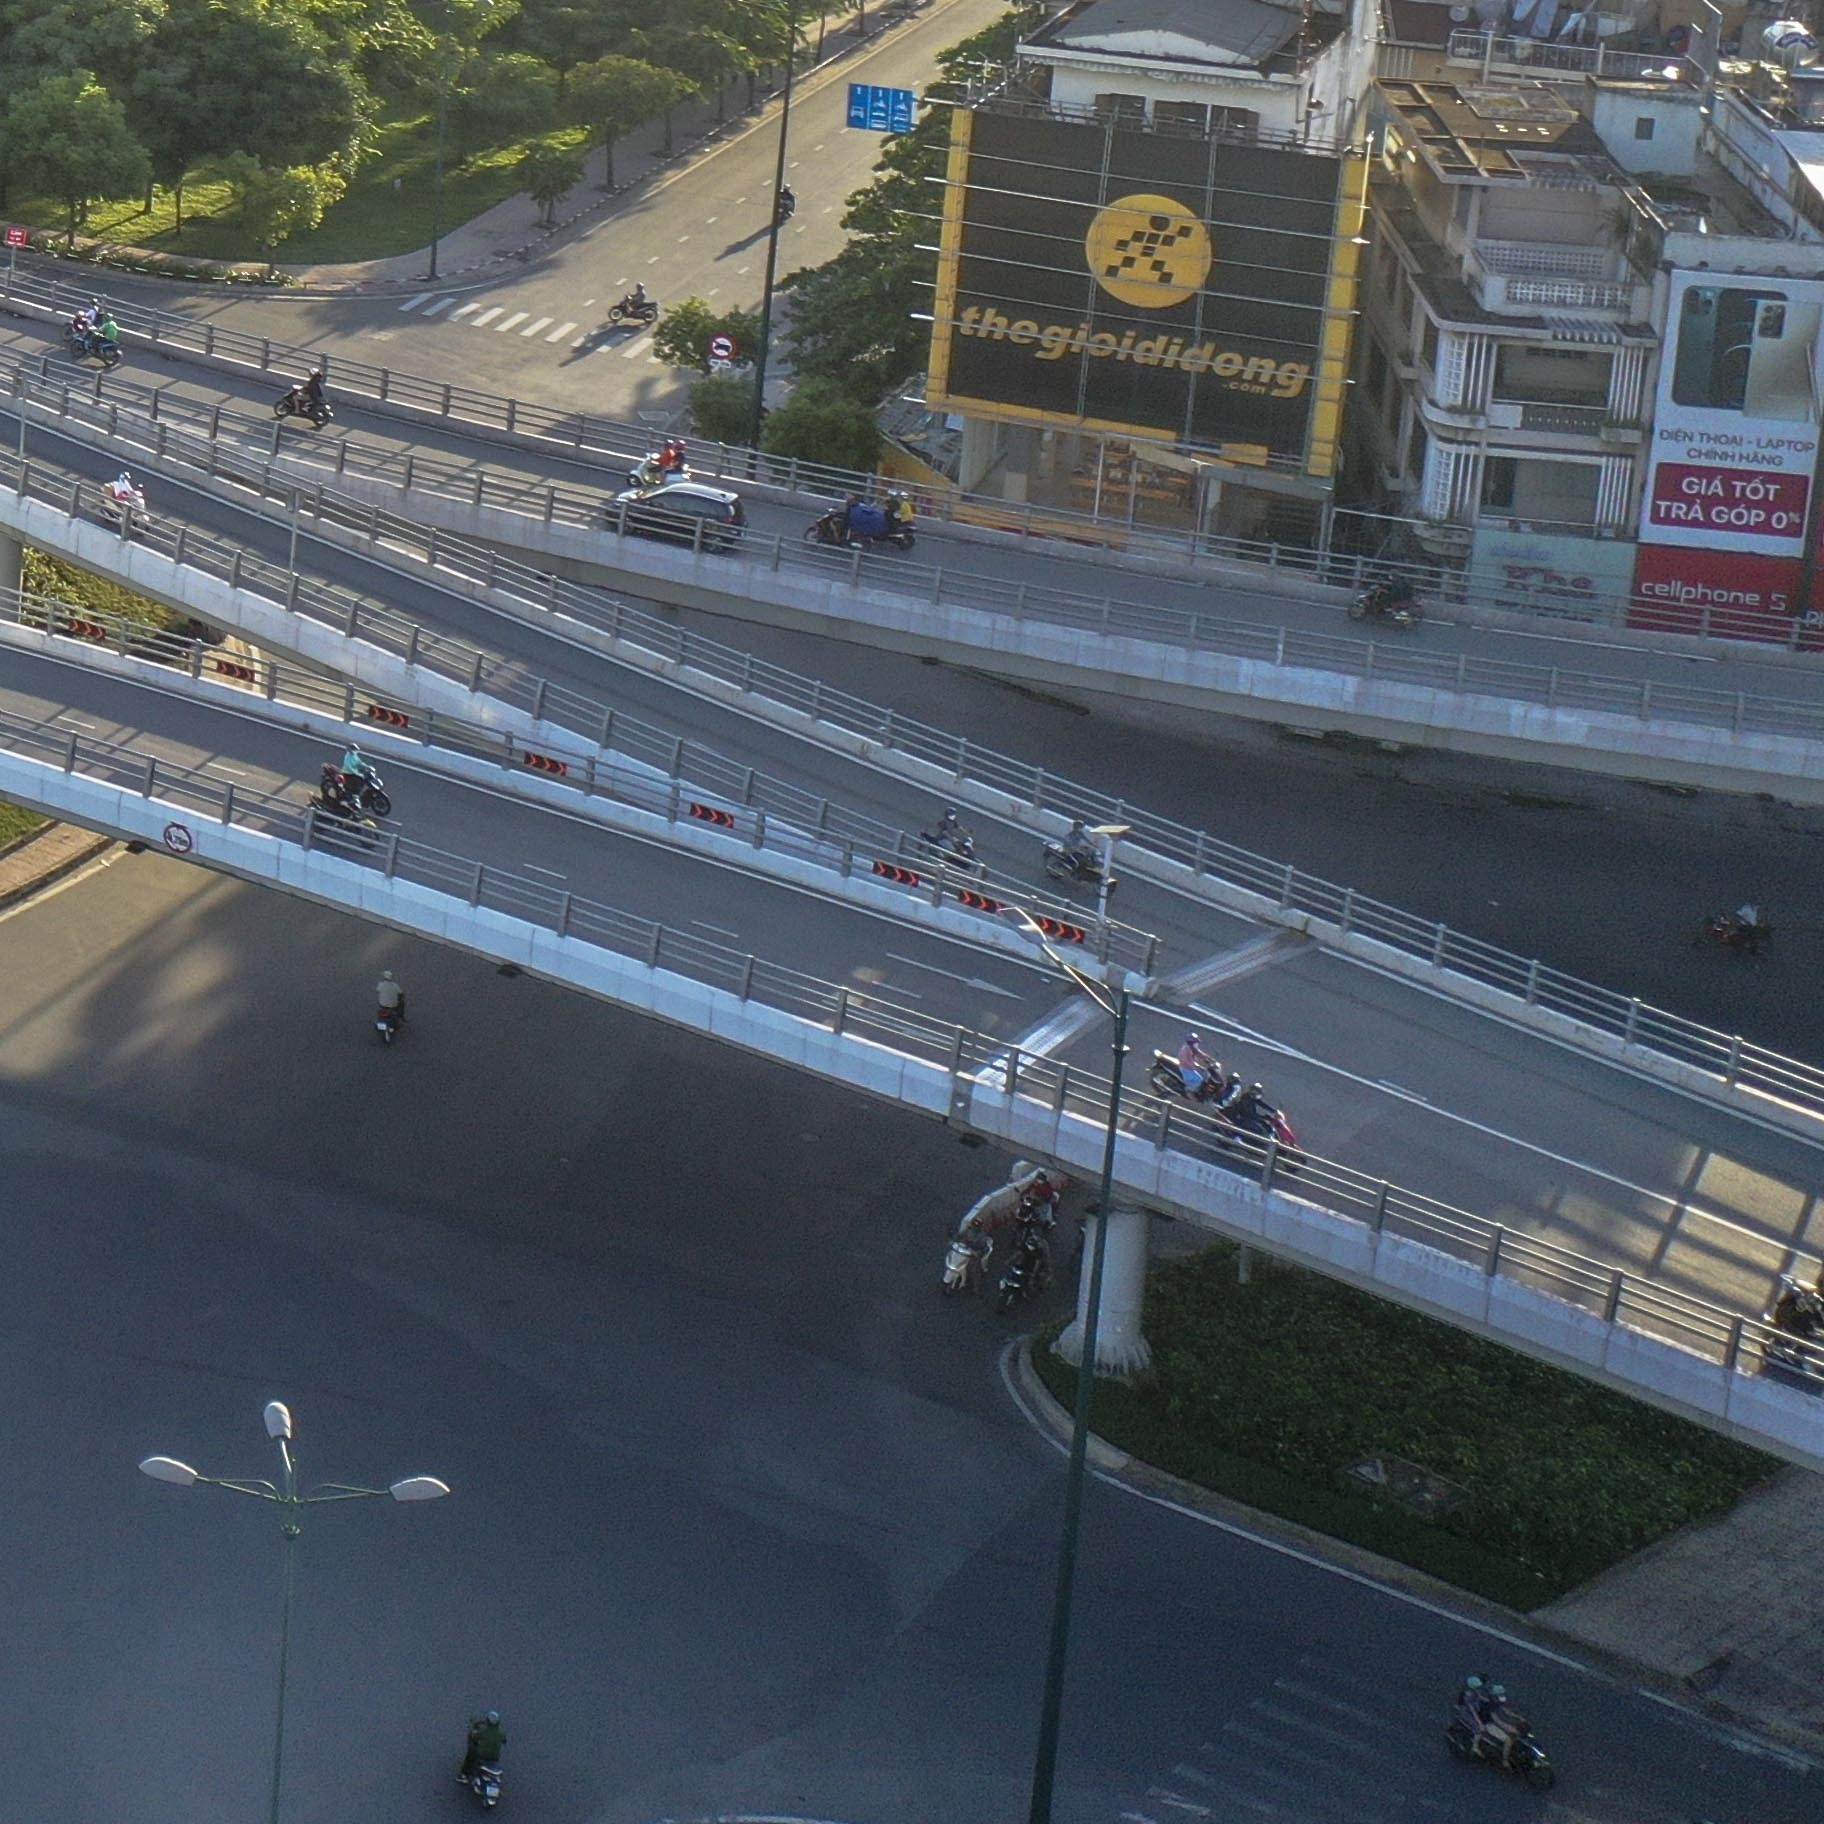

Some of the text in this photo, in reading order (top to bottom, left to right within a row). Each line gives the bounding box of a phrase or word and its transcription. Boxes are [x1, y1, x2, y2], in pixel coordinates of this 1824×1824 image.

[959, 304, 1310, 399] thegioididong
[1659, 428, 1695, 444] ĐIỆN
[1698, 431, 1744, 447] THOẠI
[1756, 435, 1816, 453] LAPTOP
[1686, 446, 1784, 467] CHÍNH HÃNG
[1681, 475, 1781, 501] GIÁ TỐT
[1656, 498, 1704, 522] TRẢ
[1711, 499, 1764, 525] GÓP
[1641, 579, 1760, 606] cellphone
